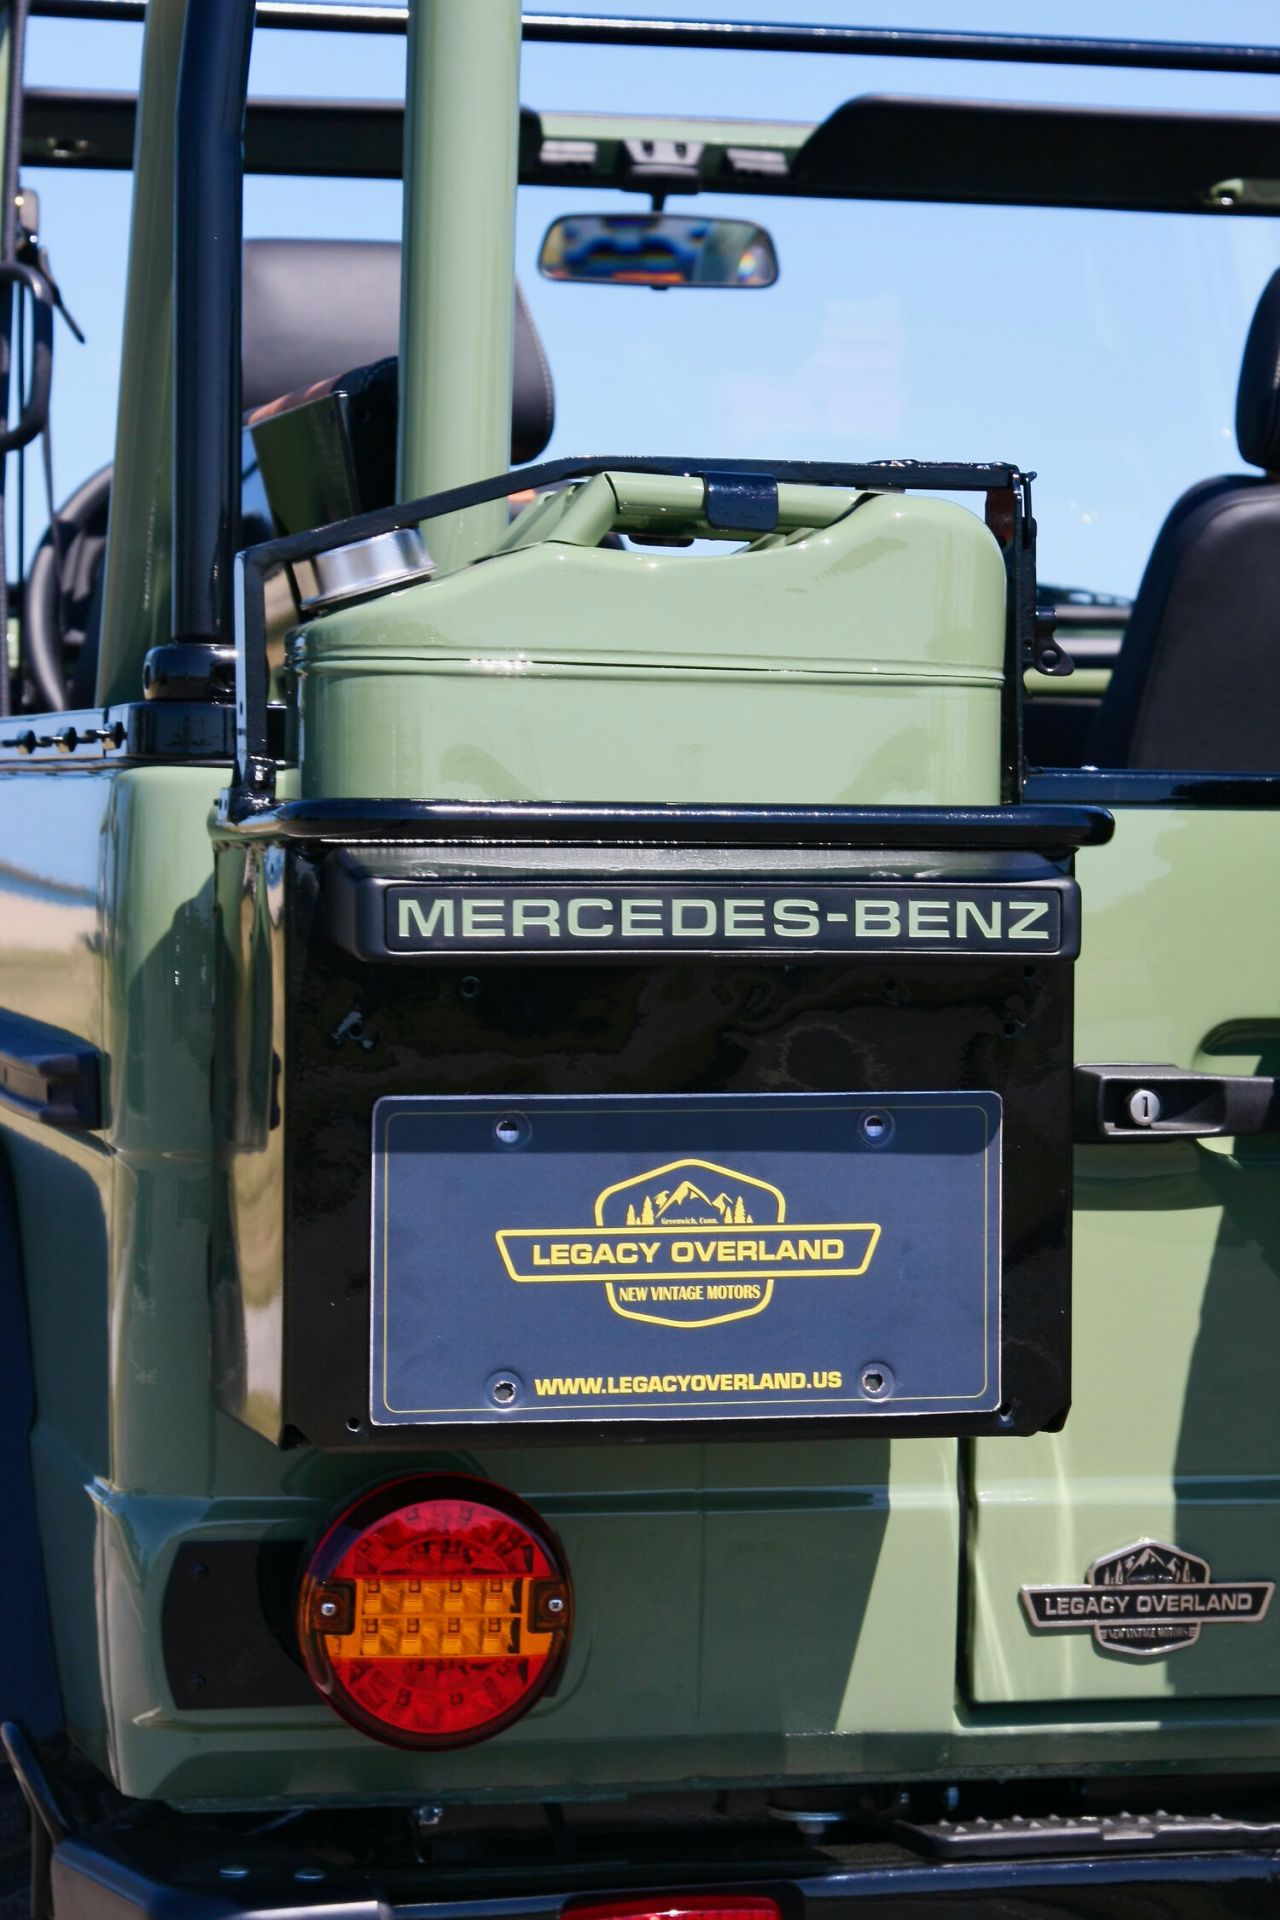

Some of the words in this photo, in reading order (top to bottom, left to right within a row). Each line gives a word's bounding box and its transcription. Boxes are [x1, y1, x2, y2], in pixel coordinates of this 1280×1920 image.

[398, 898, 1050, 940] MERCEDES-BENZ
[532, 1242, 661, 1266] LEGACY
[671, 1238, 845, 1263] OVERLAND
[619, 1287, 648, 1302] NEW
[650, 1285, 704, 1301] VINTAGE
[706, 1284, 761, 1300] MOTORS
[534, 1371, 843, 1396] WWW.LEGACYOVERLAND.US
[1045, 1595, 1130, 1616] LEGACY
[1136, 1592, 1253, 1613] OVERLAND
